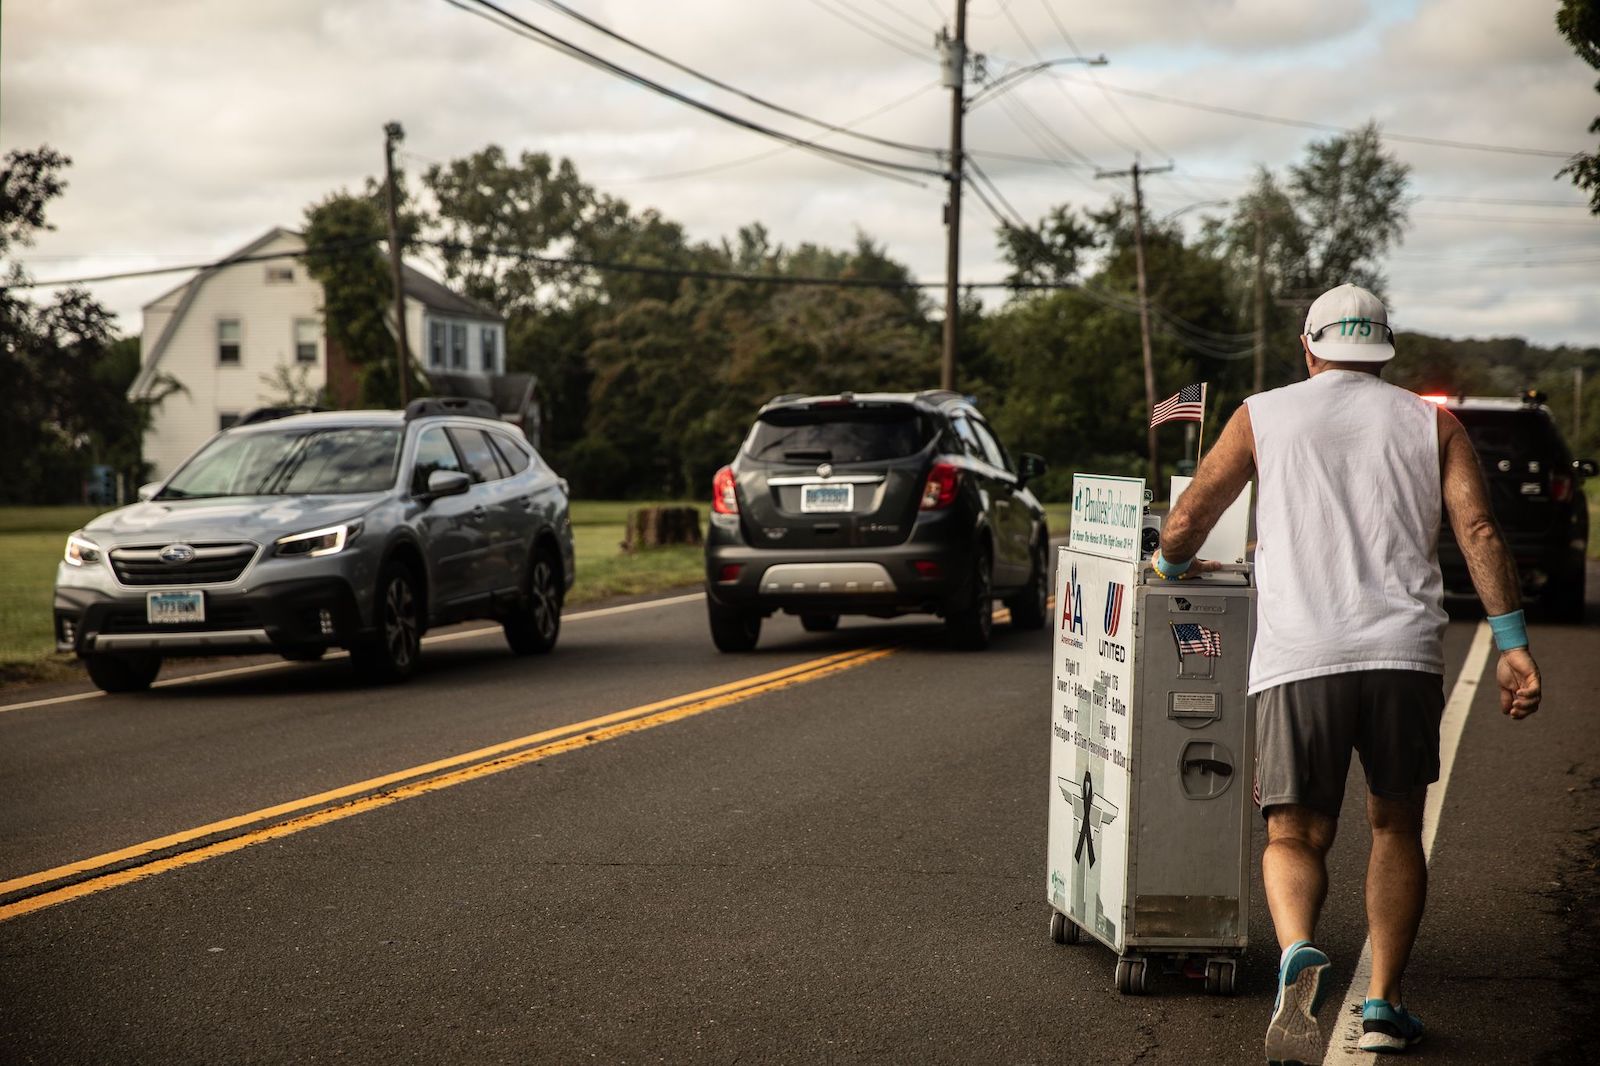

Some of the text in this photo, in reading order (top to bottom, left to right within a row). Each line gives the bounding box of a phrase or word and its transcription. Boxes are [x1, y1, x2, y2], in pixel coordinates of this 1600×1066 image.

[1340, 316, 1371, 337] 175
[1098, 638, 1126, 663] UNITED
[1065, 657, 1075, 676] Flight
[1056, 675, 1068, 693] Tower
[1100, 670, 1111, 690] Flight
[1092, 689, 1104, 707] Tower
[1063, 704, 1079, 725] Flight 77
[1099, 719, 1110, 740] Flight
